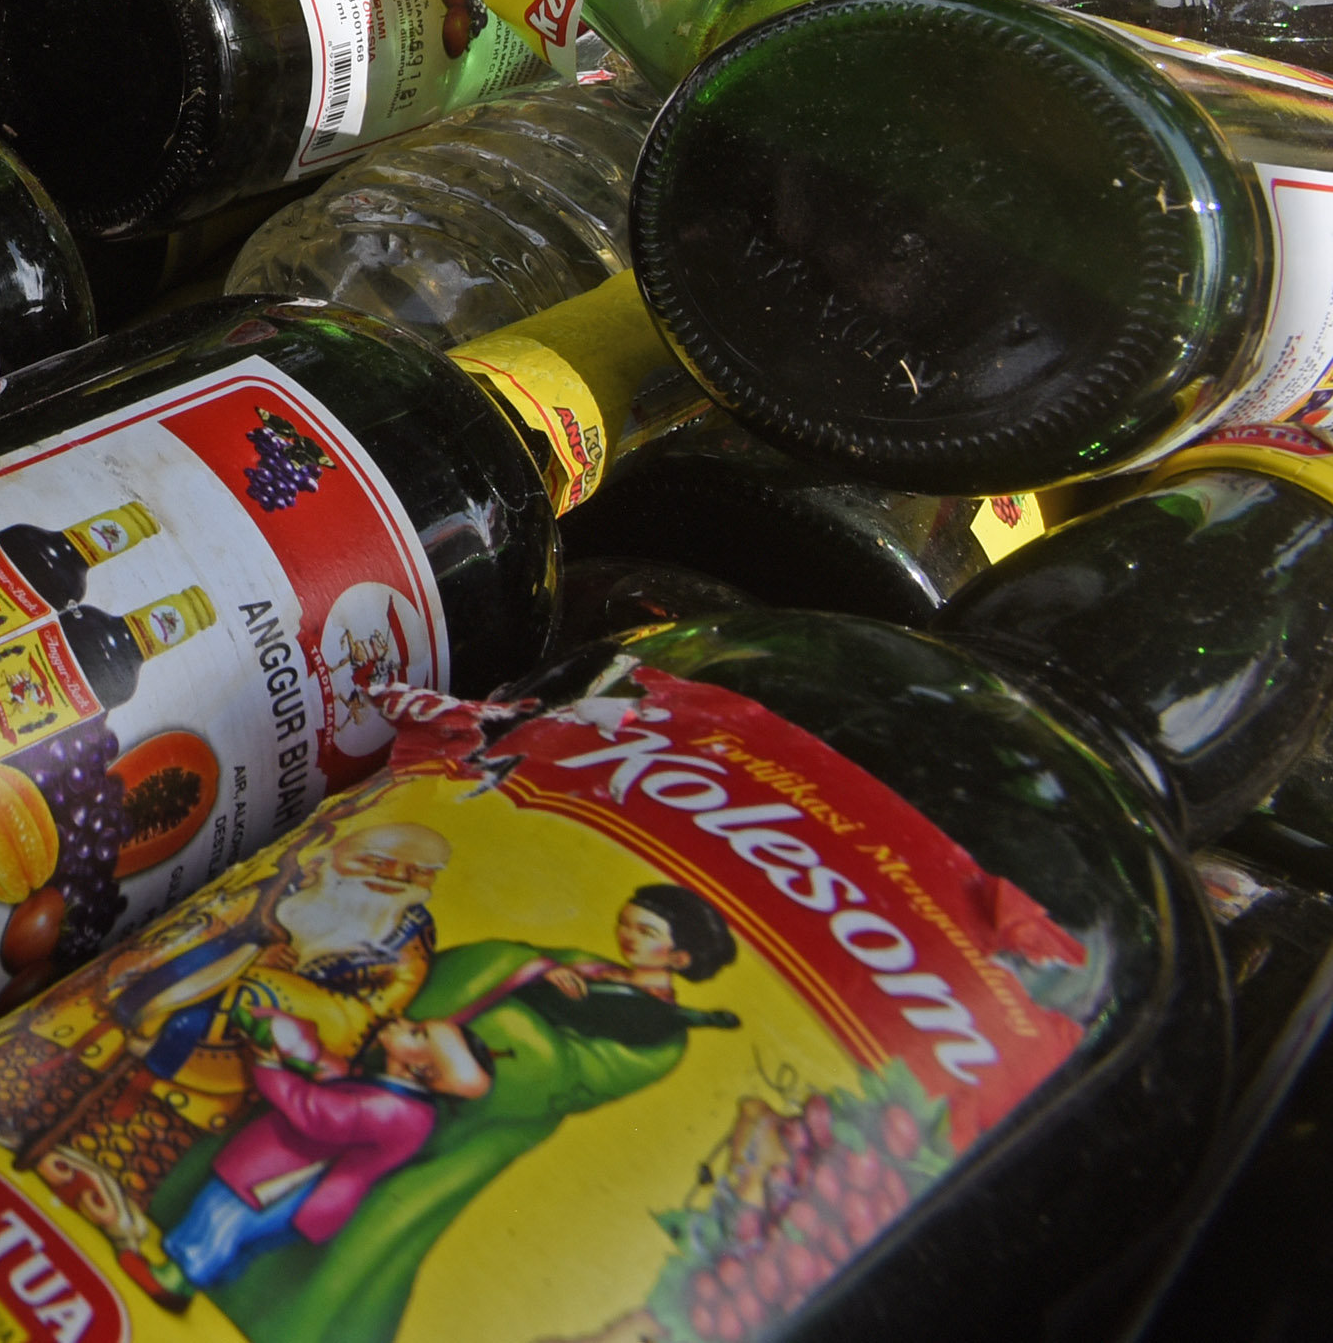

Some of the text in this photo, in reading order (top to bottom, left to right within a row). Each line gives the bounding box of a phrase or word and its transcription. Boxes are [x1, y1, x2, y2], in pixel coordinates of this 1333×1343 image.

[238, 599, 310, 830] ANGGUR BUAH
[310, 644, 332, 696] TRADE
[233, 763, 248, 800] AIR,
[554, 707, 1000, 1087] Kolesom
